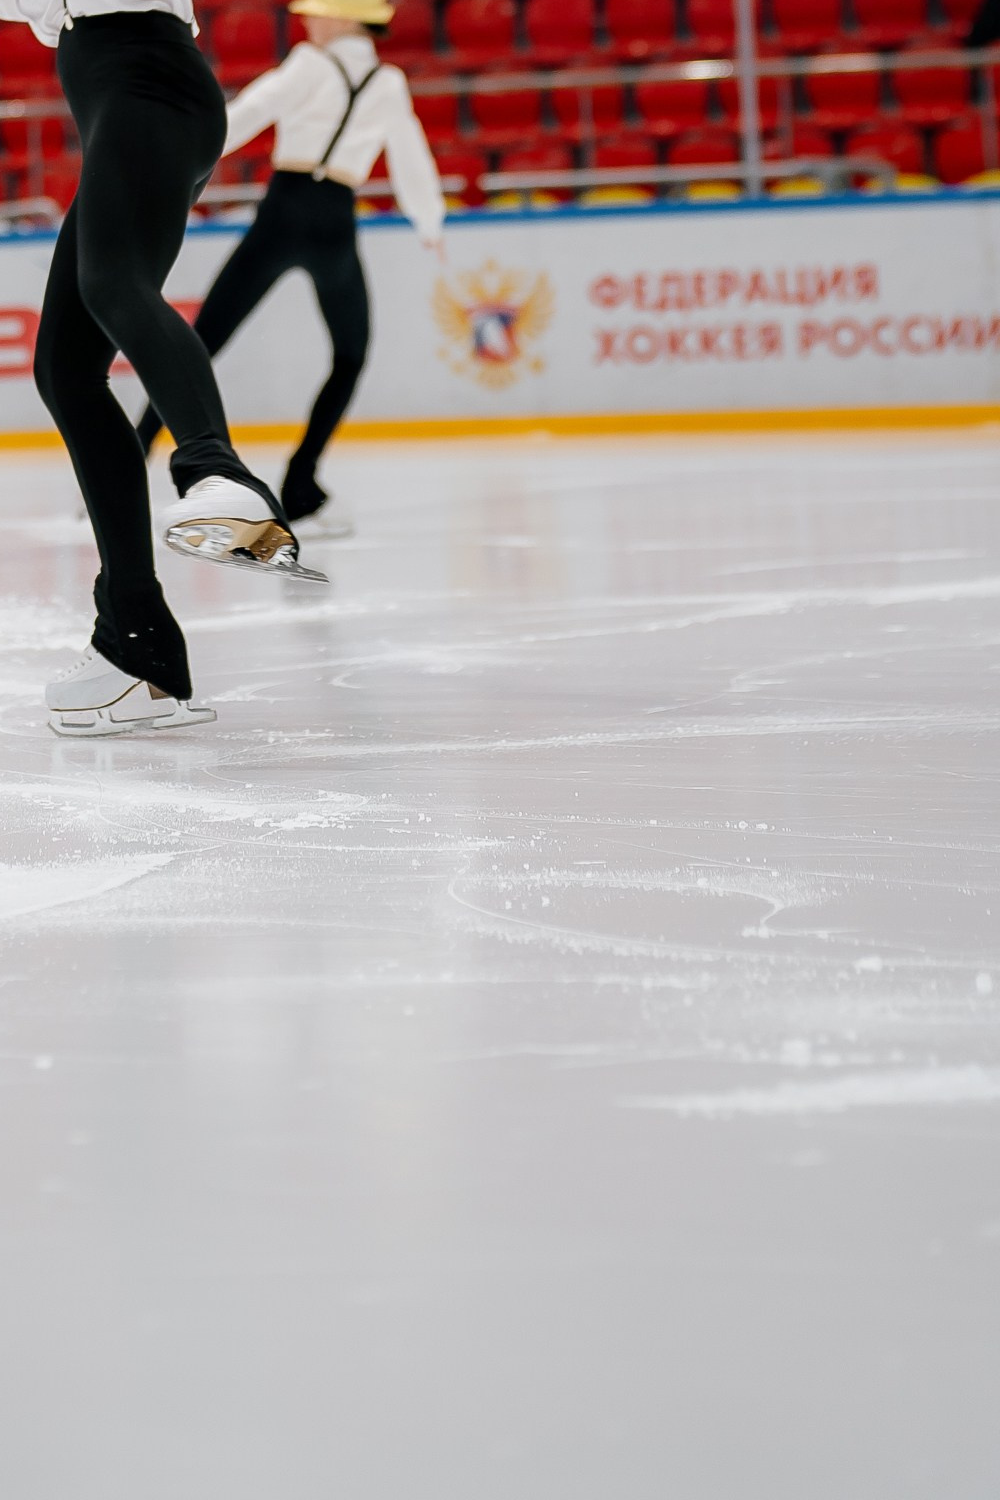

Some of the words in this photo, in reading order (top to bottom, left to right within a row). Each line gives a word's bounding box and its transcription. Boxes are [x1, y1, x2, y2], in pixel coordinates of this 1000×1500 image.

[589, 266, 879, 315] ФЕДЕРАЦИЯ
[594, 320, 784, 364] ХОККЕЯ
[797, 311, 1000, 359] РОССИИ
